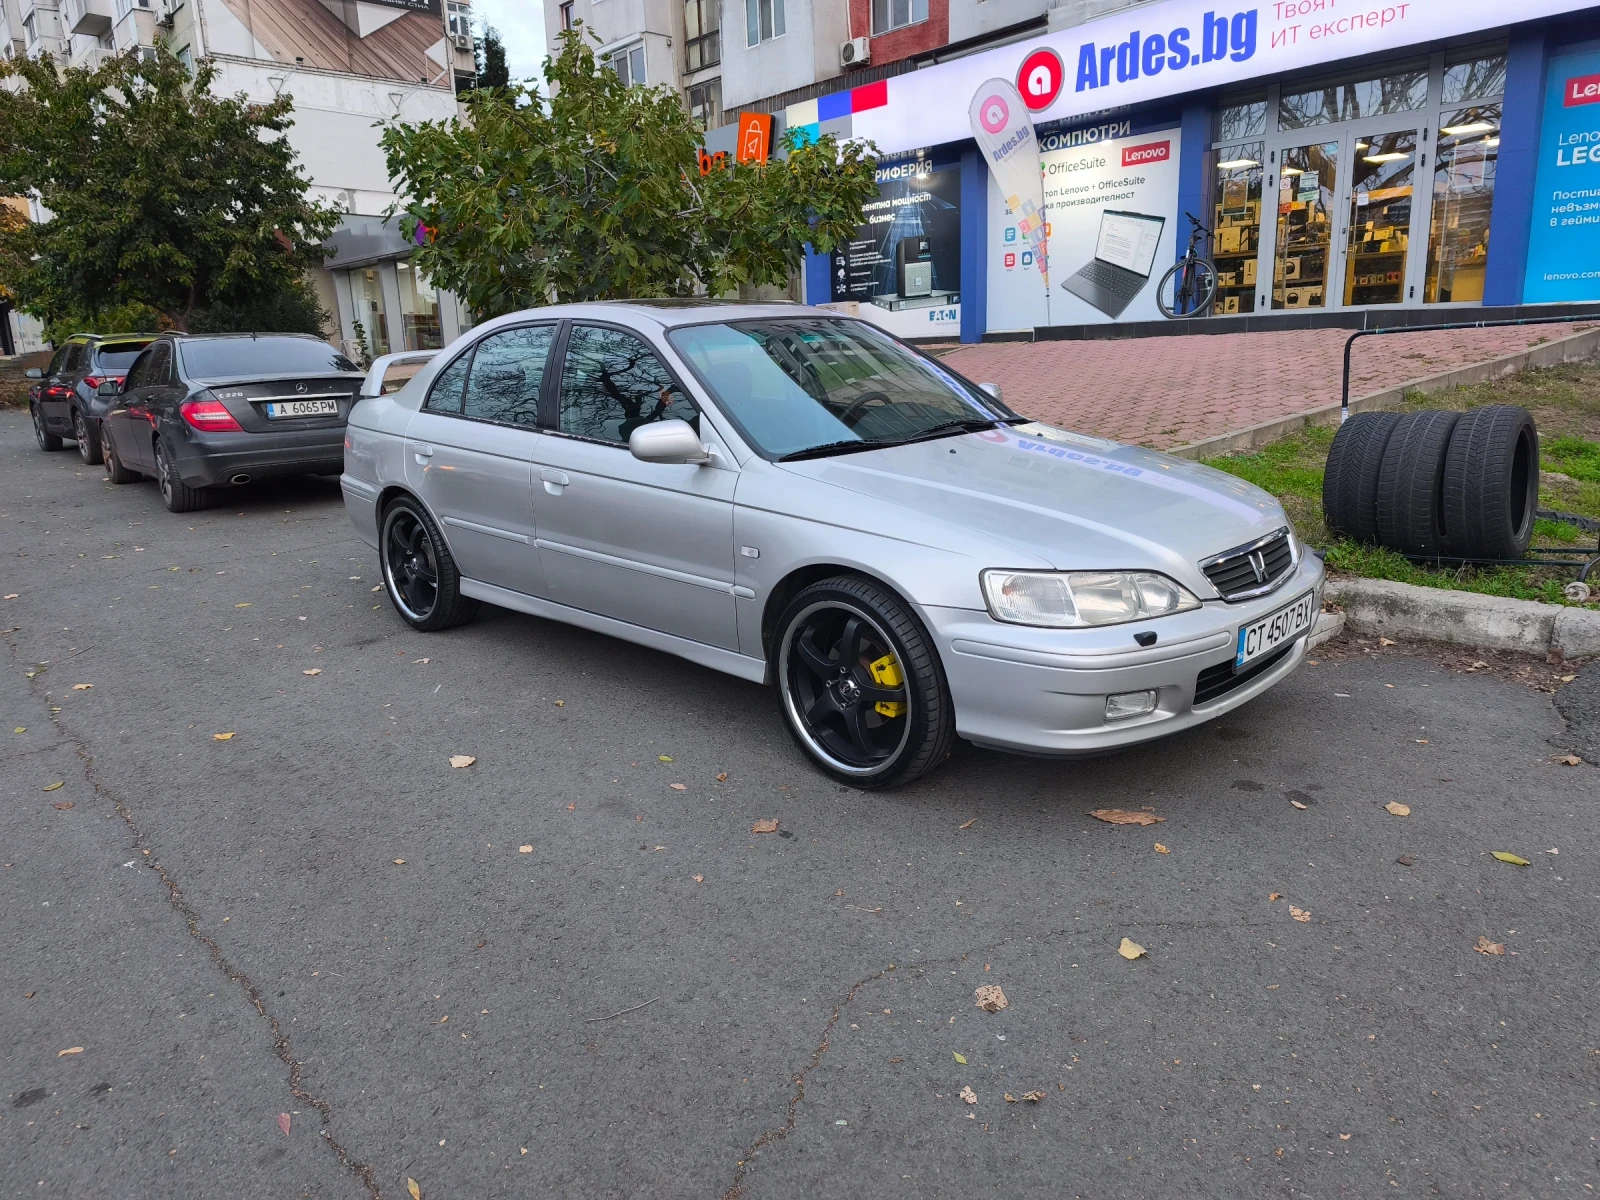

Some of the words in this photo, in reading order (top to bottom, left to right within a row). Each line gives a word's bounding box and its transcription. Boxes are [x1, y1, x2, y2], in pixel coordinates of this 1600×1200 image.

[1271, 25, 1302, 48] ИТ
[1309, 4, 1410, 40] експерт
[1075, 8, 1258, 93] Ardes.bg
[993, 126, 1030, 162] Ardes.bg
[1038, 120, 1131, 152] КОМПЮТРИ
[1048, 157, 1106, 175] OfficeSuite
[1125, 147, 1166, 162] Lenovo
[1060, 184, 1090, 196] Lenovo
[1098, 176, 1146, 190] OfficeSuite
[1056, 191, 1135, 210] производителност
[869, 213, 896, 224] бизнес
[1246, 622, 1266, 656] CT
[1266, 606, 1296, 644] 4507
[1296, 597, 1311, 630] BX
